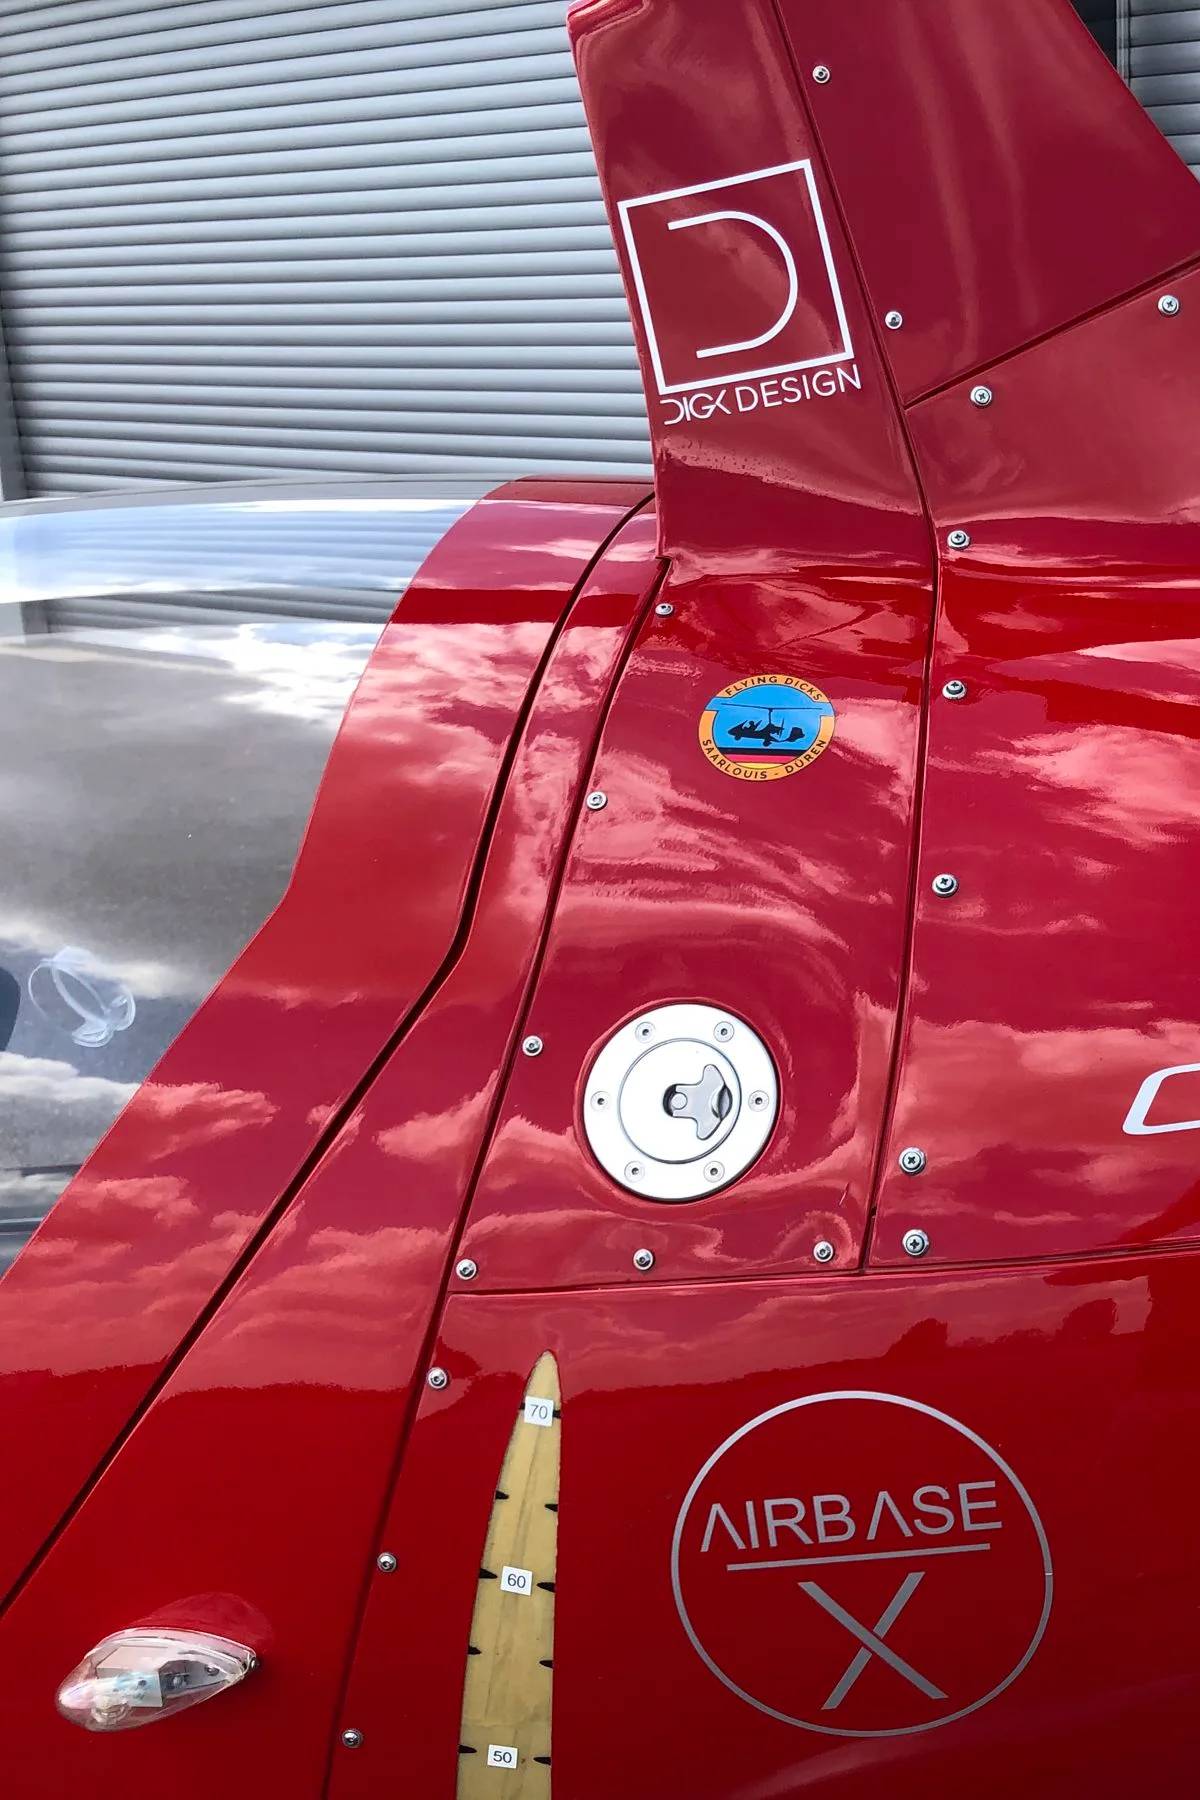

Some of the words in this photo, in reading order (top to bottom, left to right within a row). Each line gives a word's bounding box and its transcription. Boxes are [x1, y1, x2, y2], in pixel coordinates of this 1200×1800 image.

[735, 364, 862, 413] DESIGN
[725, 676, 778, 696] FLYING
[785, 677, 823, 701] DICKS
[702, 739, 767, 779] SAARLOUIS
[529, 1404, 549, 1420] 70
[700, 1480, 1003, 1553] AIRBASE
[507, 1573, 526, 1589] 60
[797, 1571, 949, 1711] X
[493, 1751, 512, 1764] 50
